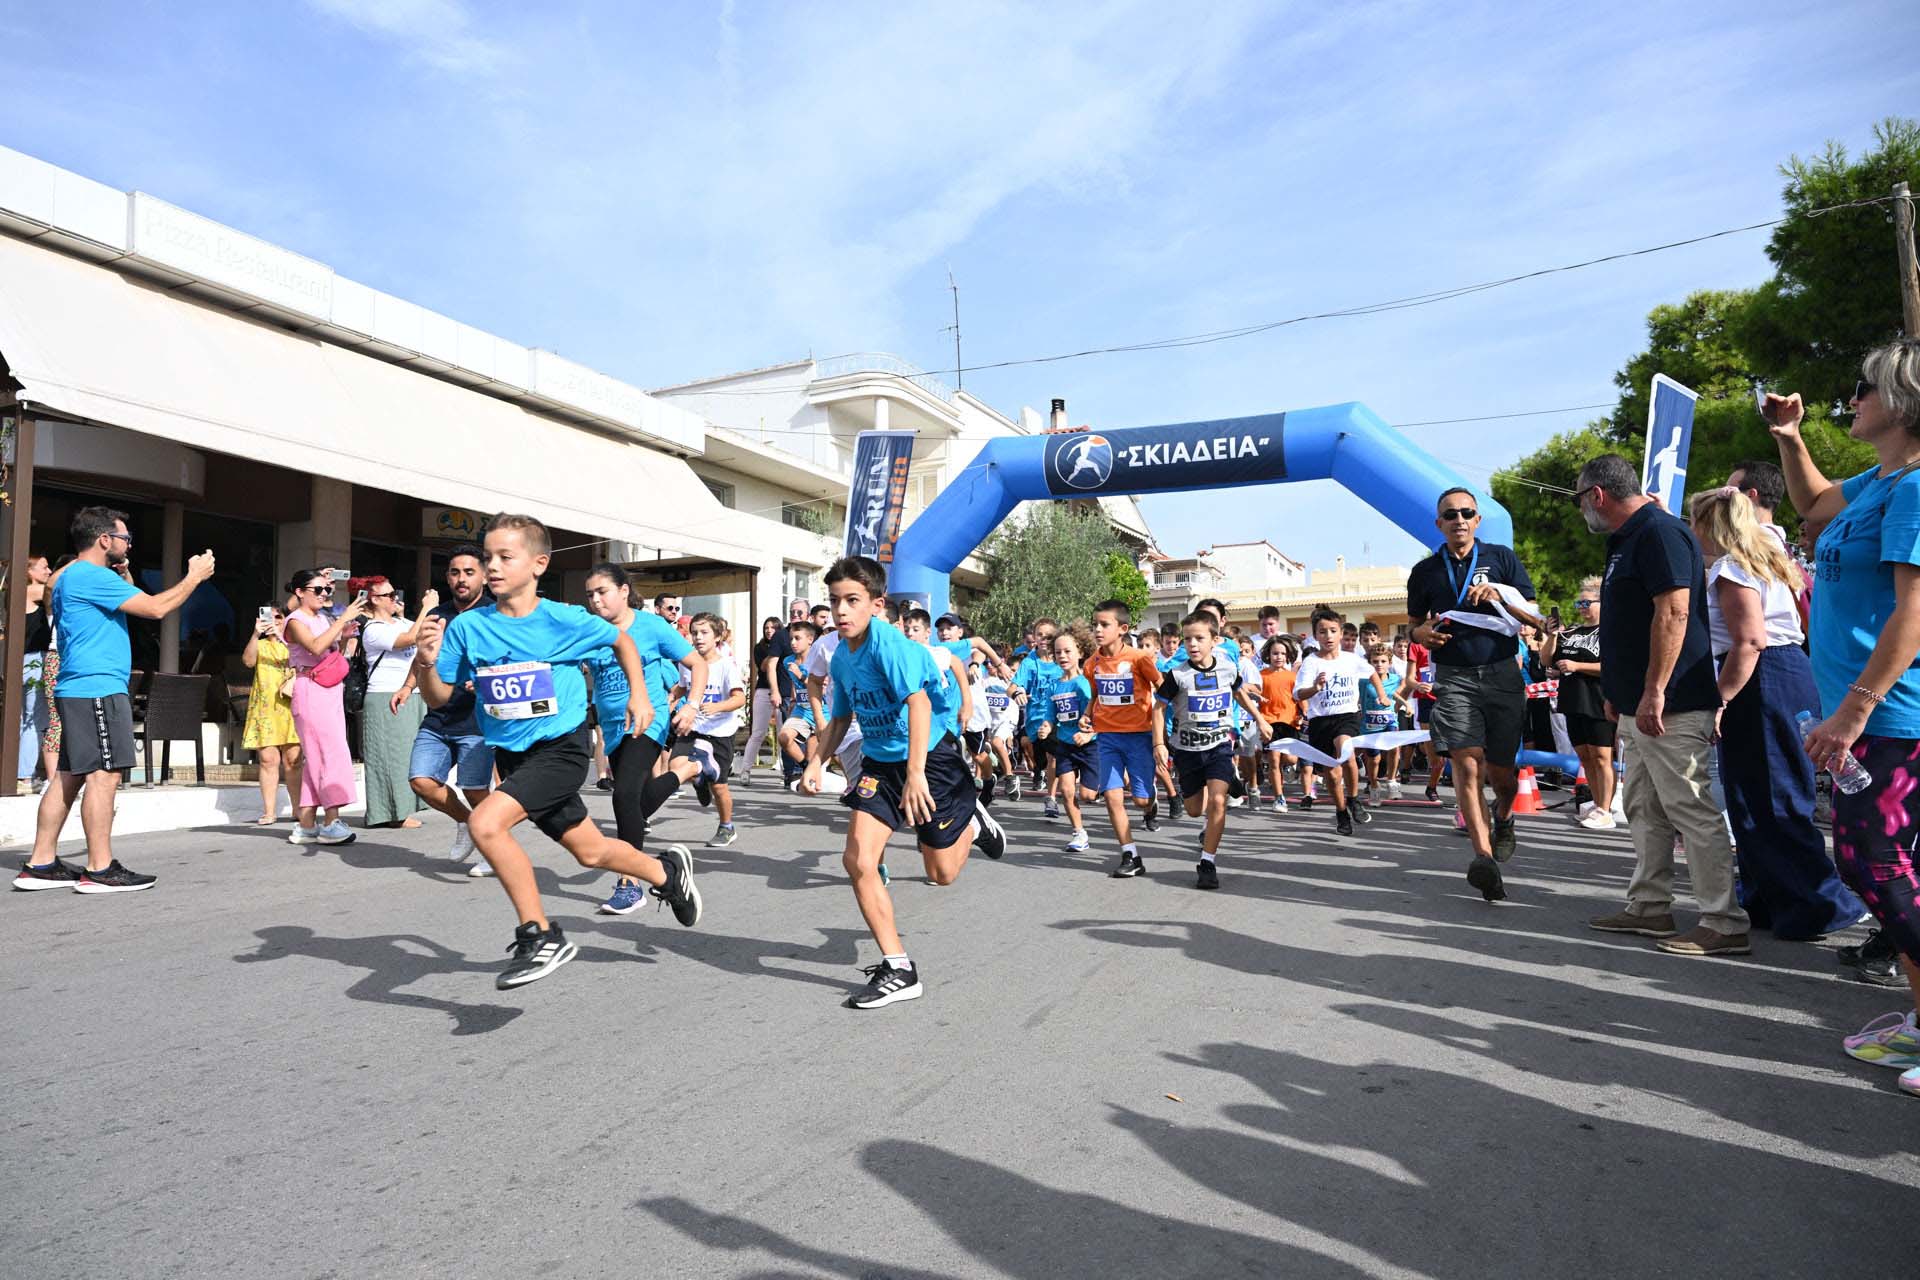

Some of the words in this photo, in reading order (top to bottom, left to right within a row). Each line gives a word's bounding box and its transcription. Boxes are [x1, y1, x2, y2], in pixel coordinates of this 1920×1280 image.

[144, 206, 209, 258] Pizza
[866, 456, 889, 522] RUN
[491, 675, 536, 700] 667
[1100, 681, 1126, 694] 796
[988, 697, 1005, 705] 699
[1197, 696, 1223, 710] 795
[1370, 714, 1390, 724] 763
[1180, 727, 1230, 747] SPORT
